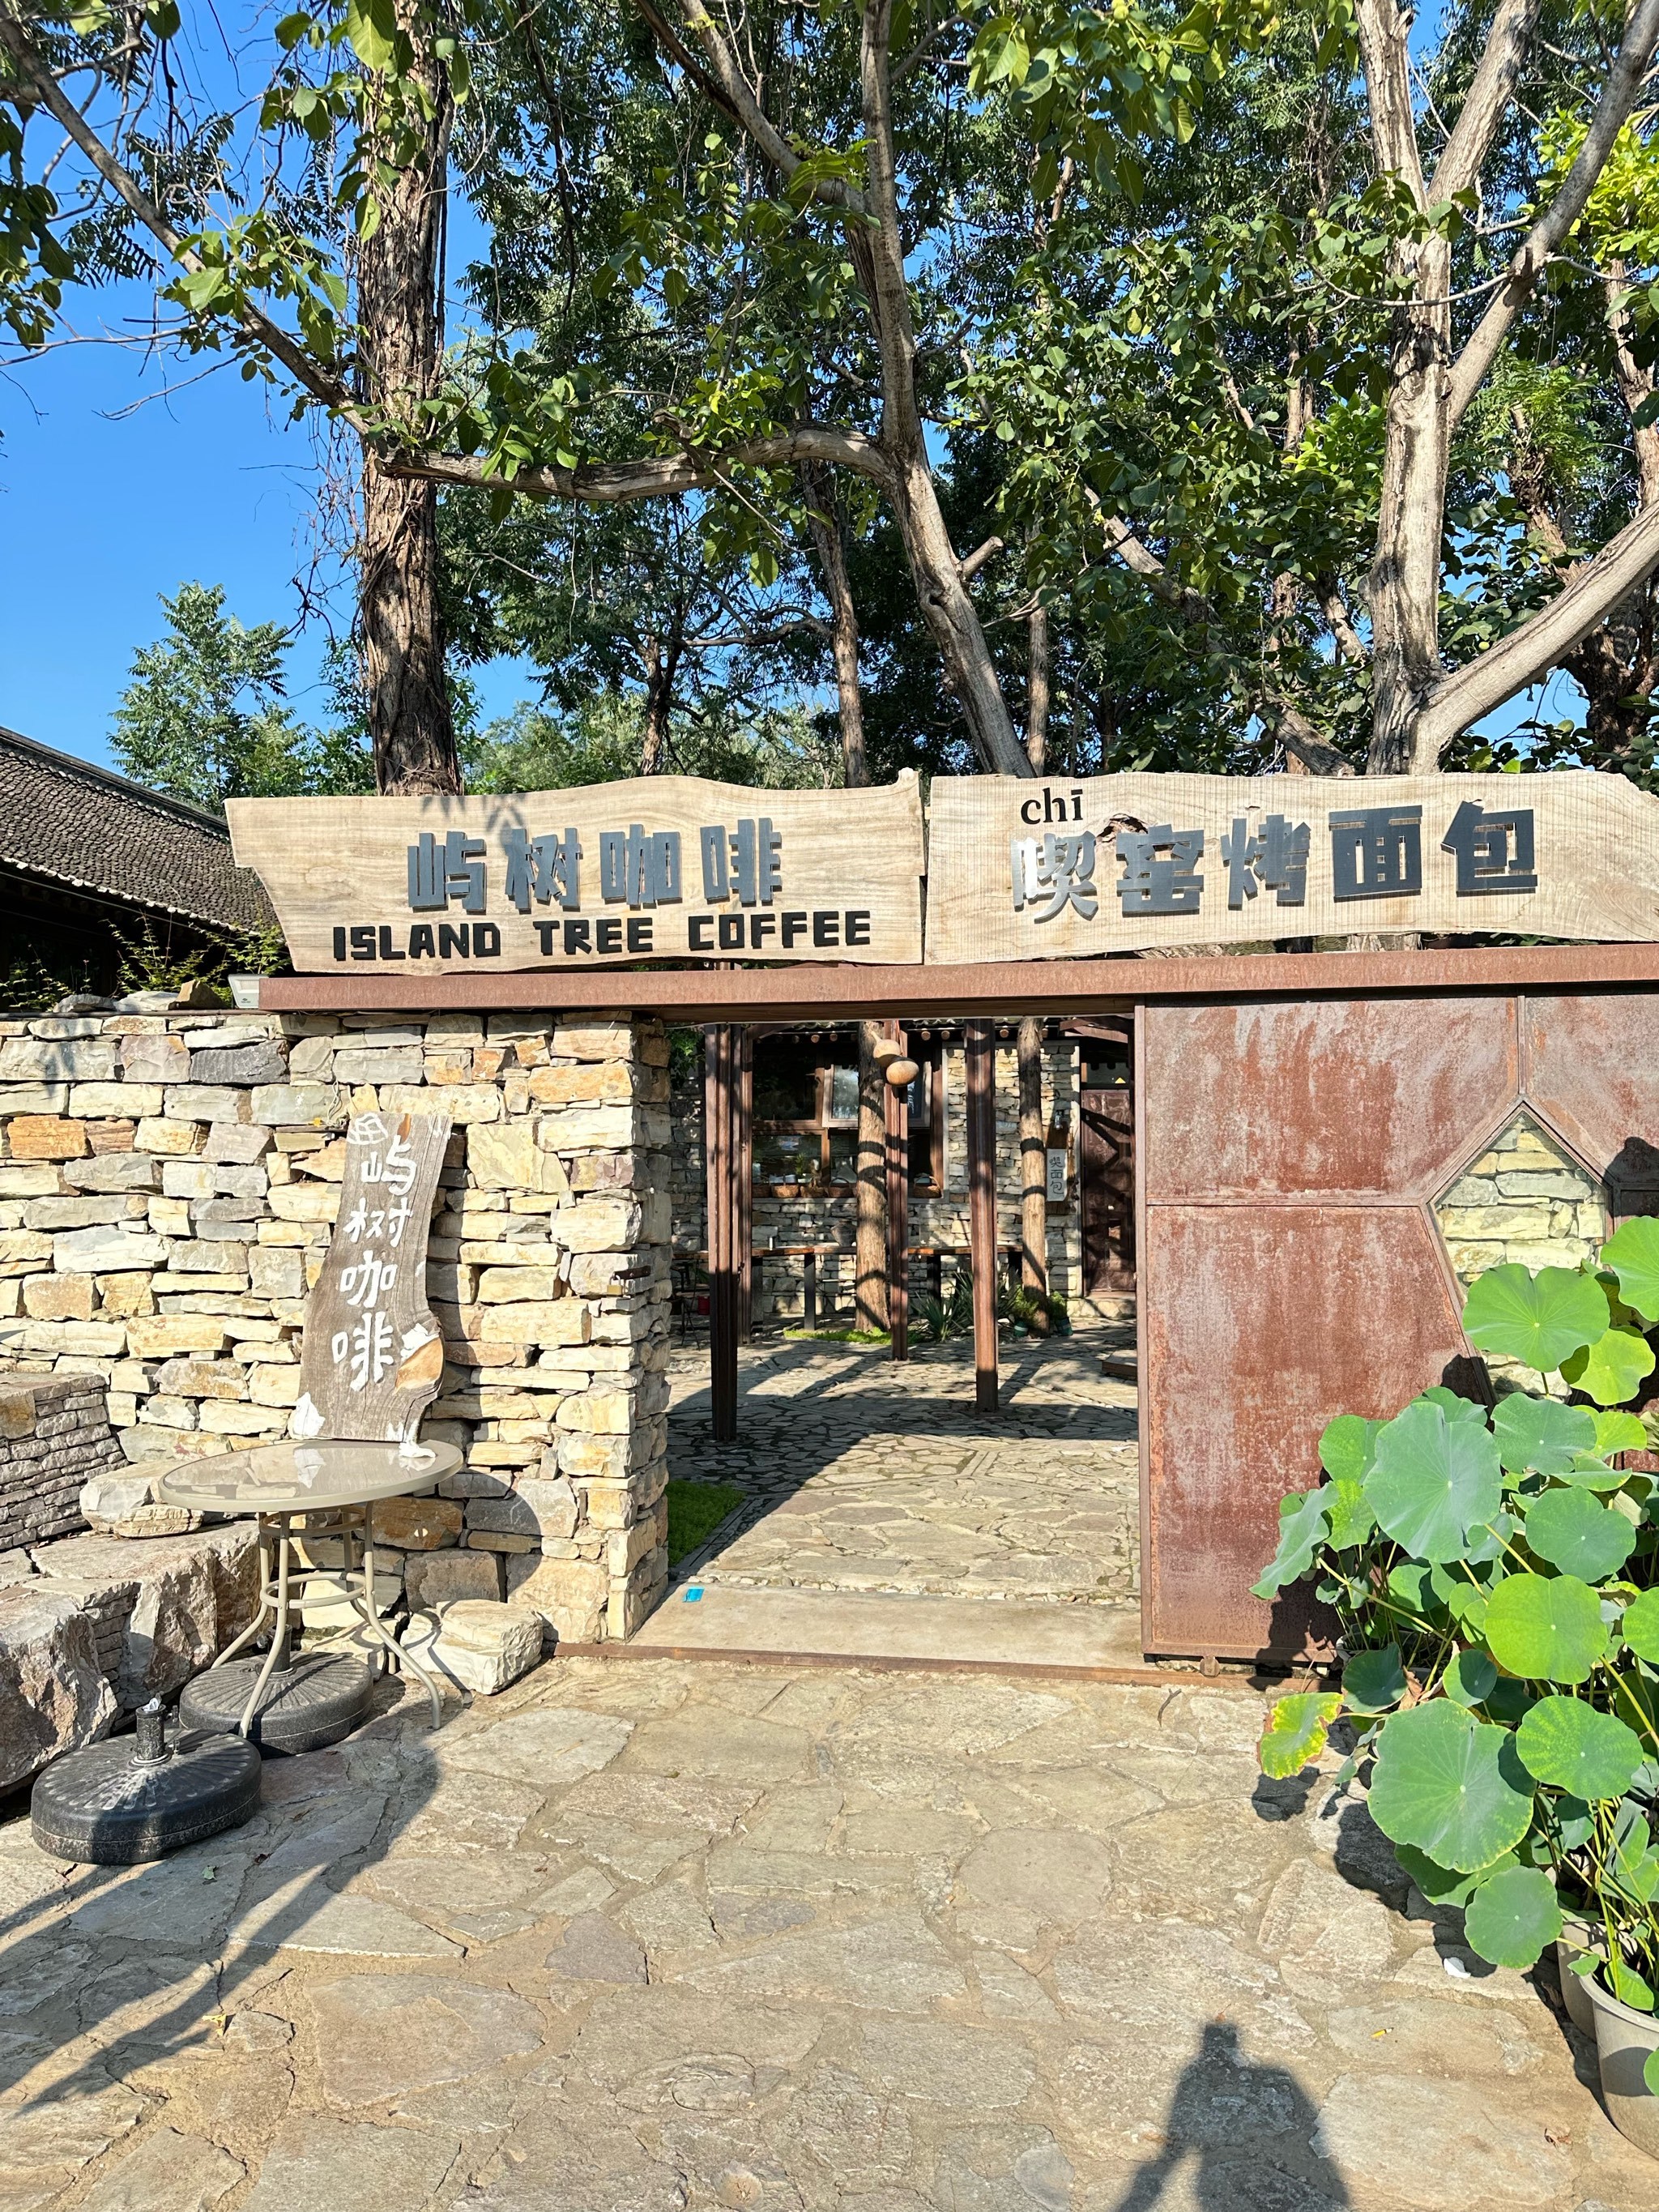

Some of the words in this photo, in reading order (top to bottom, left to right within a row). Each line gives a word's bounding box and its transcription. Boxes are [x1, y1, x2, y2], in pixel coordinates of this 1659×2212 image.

[1020, 787, 1084, 825] chī
[407, 818, 783, 913] 屿树咖啡
[1011, 801, 1537, 923] 喫窑烤面包
[333, 923, 501, 962] ISLAND
[533, 917, 654, 956] TREE
[688, 911, 871, 951] COFFEE
[331, 1134, 416, 1392] 屿树咖啡
